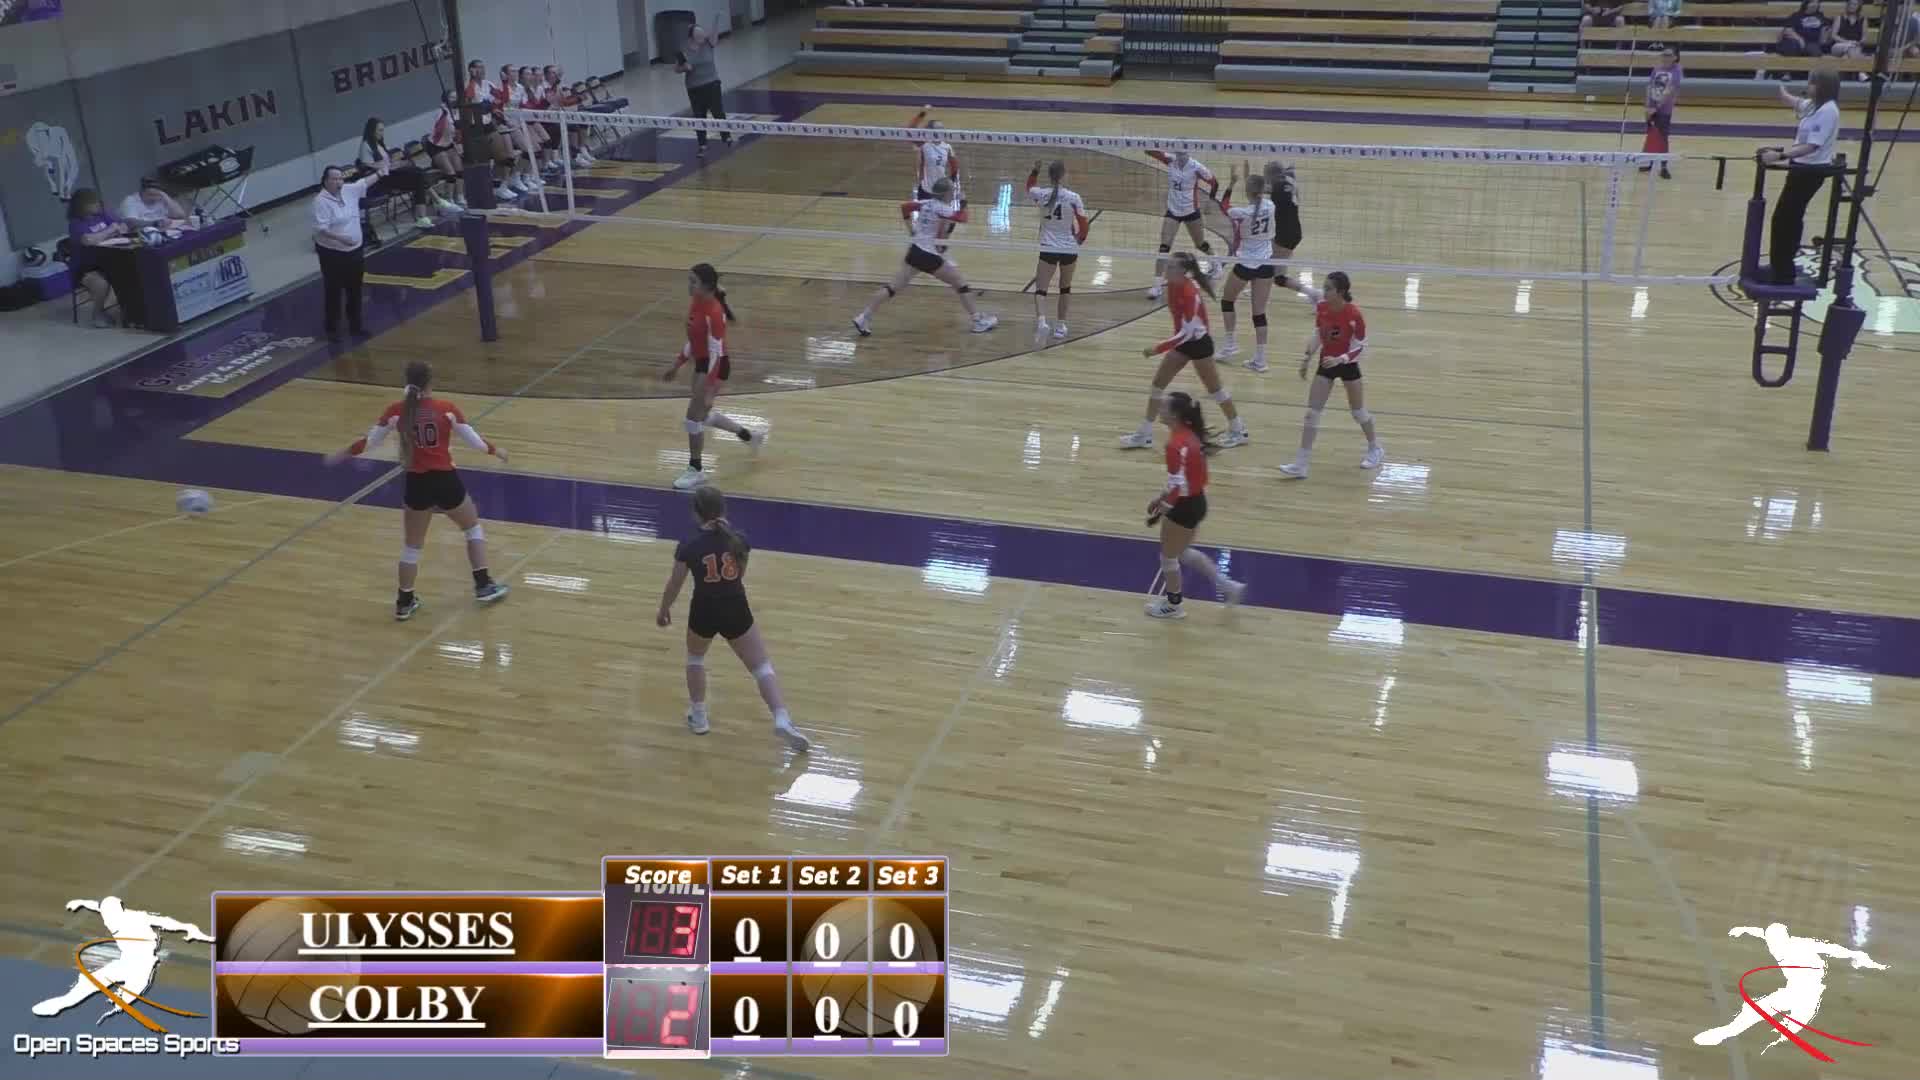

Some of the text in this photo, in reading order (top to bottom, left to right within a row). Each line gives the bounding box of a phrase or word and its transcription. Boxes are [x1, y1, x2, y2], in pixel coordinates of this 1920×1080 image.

[153, 89, 278, 145] LAKIN
[1251, 216, 1270, 235] 27
[415, 422, 441, 449] 10
[703, 552, 740, 583] 18
